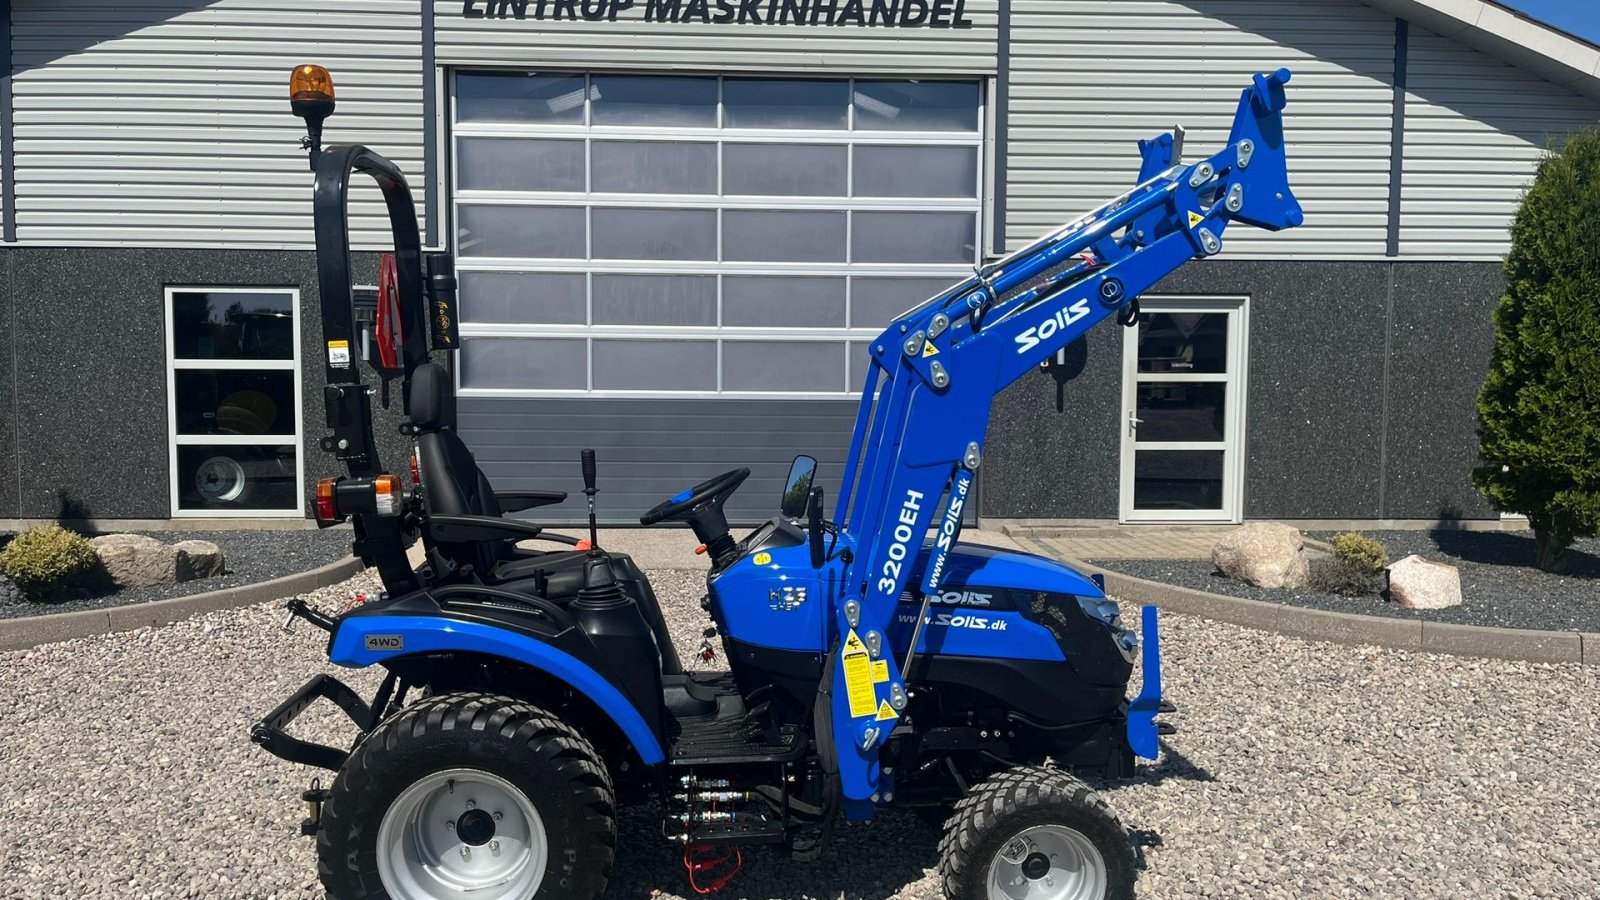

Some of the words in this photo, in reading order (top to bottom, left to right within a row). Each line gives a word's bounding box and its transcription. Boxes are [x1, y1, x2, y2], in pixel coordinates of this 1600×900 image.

[644, 0, 974, 29] MASKINHANDEL
[877, 489, 924, 596] 3200EH
[368, 637, 400, 647] 4WD
